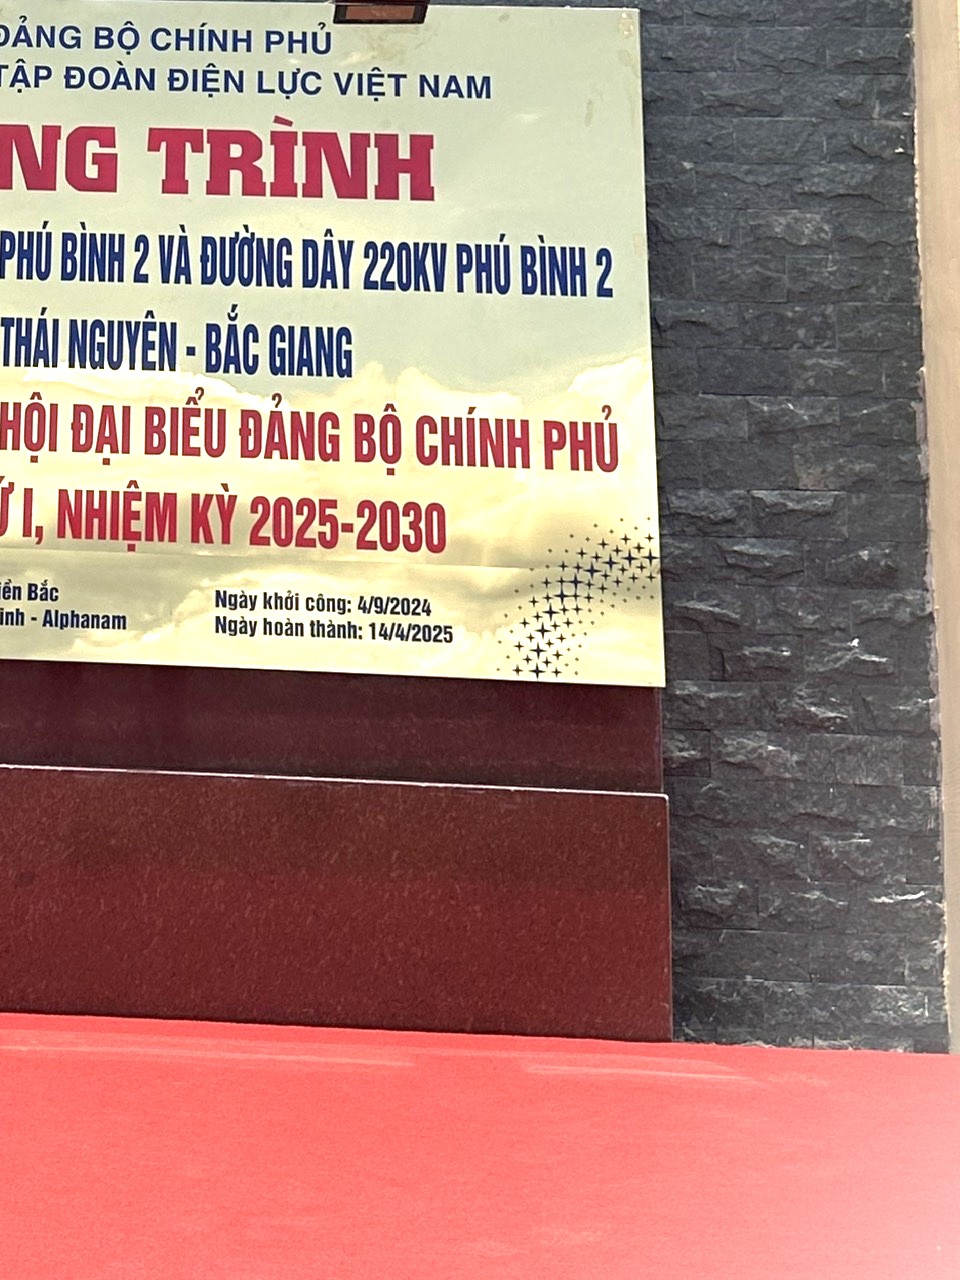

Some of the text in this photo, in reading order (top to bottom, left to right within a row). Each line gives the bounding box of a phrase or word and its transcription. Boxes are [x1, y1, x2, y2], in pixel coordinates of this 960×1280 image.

[94, 21, 139, 55] BỘ
[150, 23, 251, 52] CHÍNH
[266, 22, 331, 54] PHỦ
[64, 61, 155, 91] ĐOÀN
[168, 63, 243, 97] ĐIỆN
[258, 68, 321, 99] LỰC
[334, 67, 407, 101] VIỆT
[420, 75, 491, 99] NAM
[147, 115, 434, 201] TRÌNH
[0, 221, 52, 281] PHÚ
[61, 222, 125, 282] BÌNH
[133, 234, 149, 283] 2
[159, 224, 191, 284] VÀ
[200, 224, 292, 288] ĐƯỜNG
[302, 229, 354, 289] DÂY
[364, 241, 447, 292] 220KV
[456, 234, 510, 295] PHÚ
[521, 235, 587, 297] BÌNH
[596, 248, 613, 298] 2
[1, 307, 59, 368] THÁI
[68, 310, 177, 371] NGUYÊN
[206, 304, 259, 375] BẮC
[269, 325, 352, 378] GIANG
[0, 392, 58, 463] HỘI
[71, 404, 130, 465] ĐẠI
[145, 387, 226, 458] BIỂU
[239, 393, 340, 462] ĐẢNG
[354, 403, 401, 476] BỘ
[416, 407, 530, 469] CHÍNH
[544, 405, 618, 472] PHỦ
[23, 488, 43, 545] I,
[57, 480, 177, 552] NHIỆM
[191, 483, 237, 544] KỲ
[250, 496, 446, 553] 2025-2030
[27, 580, 58, 602] Bắc
[215, 590, 431, 616] Ngày khởi công: 4/9/2024
[42, 609, 126, 630] Alphanam
[215, 616, 453, 643] Ngày hoàn thành: 14/4/2025
